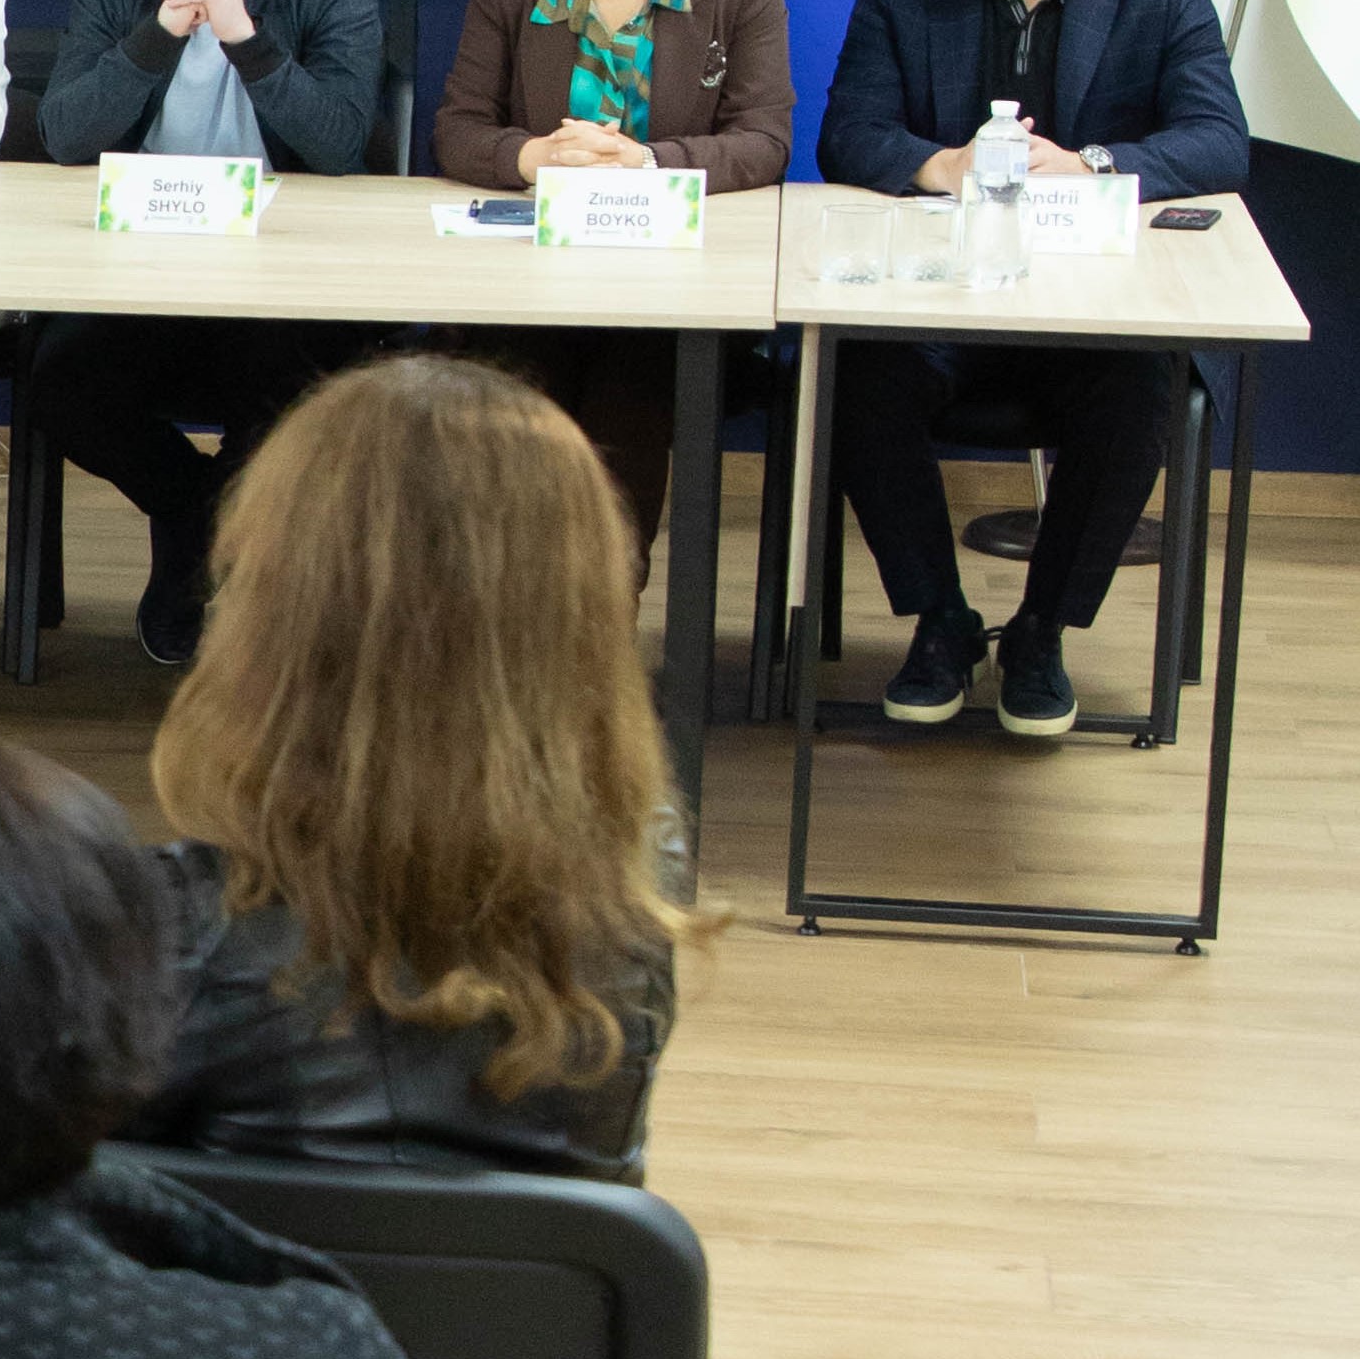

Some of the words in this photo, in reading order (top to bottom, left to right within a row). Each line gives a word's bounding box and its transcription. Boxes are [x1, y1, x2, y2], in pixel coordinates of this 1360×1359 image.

[152, 178, 204, 196] Serhiy
[148, 199, 206, 214] SHYLO
[588, 191, 650, 207] Zinaida
[586, 212, 650, 227] BOYKO
